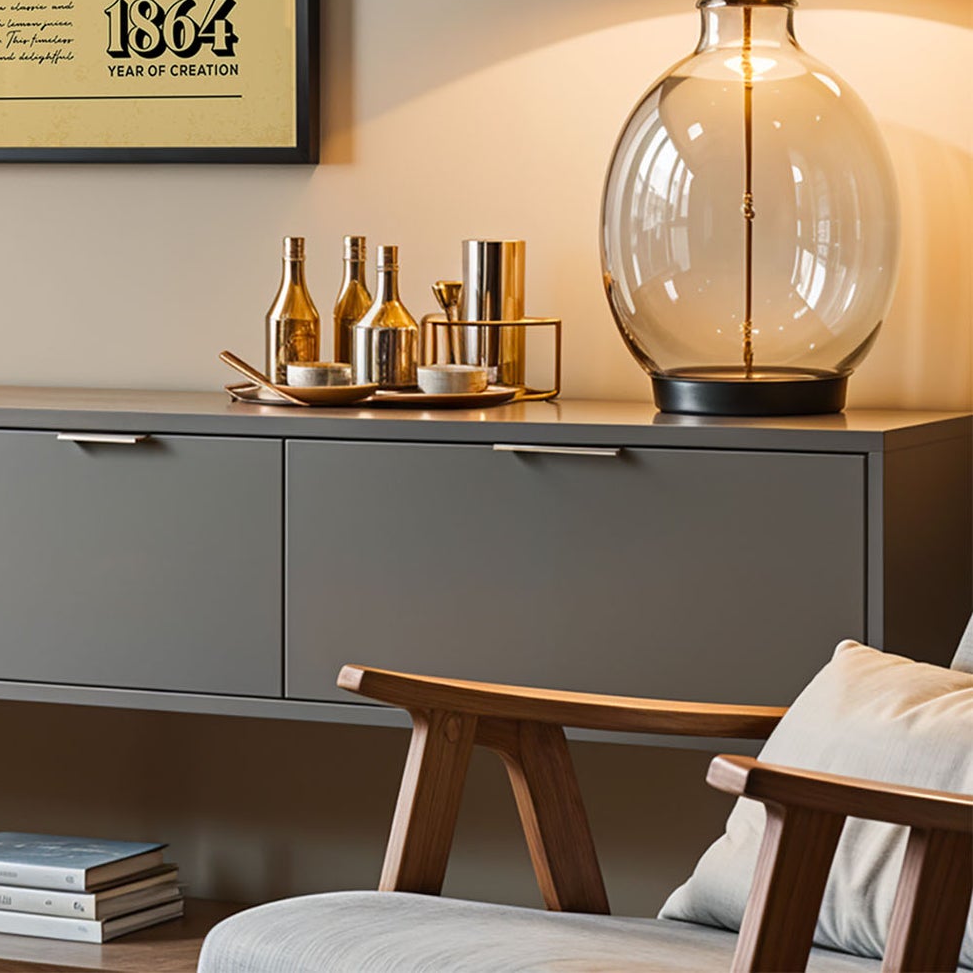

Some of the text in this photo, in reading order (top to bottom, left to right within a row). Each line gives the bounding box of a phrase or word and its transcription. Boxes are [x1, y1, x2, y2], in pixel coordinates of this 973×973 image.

[10, 1, 47, 12] classic
[51, 1, 74, 11] and
[6, 18, 41, 29] lemon
[5, 29, 30, 49] This
[29, 33, 74, 48] timeless
[18, 48, 75, 65] delightful
[107, 63, 239, 77] YEAR OF CREATION
